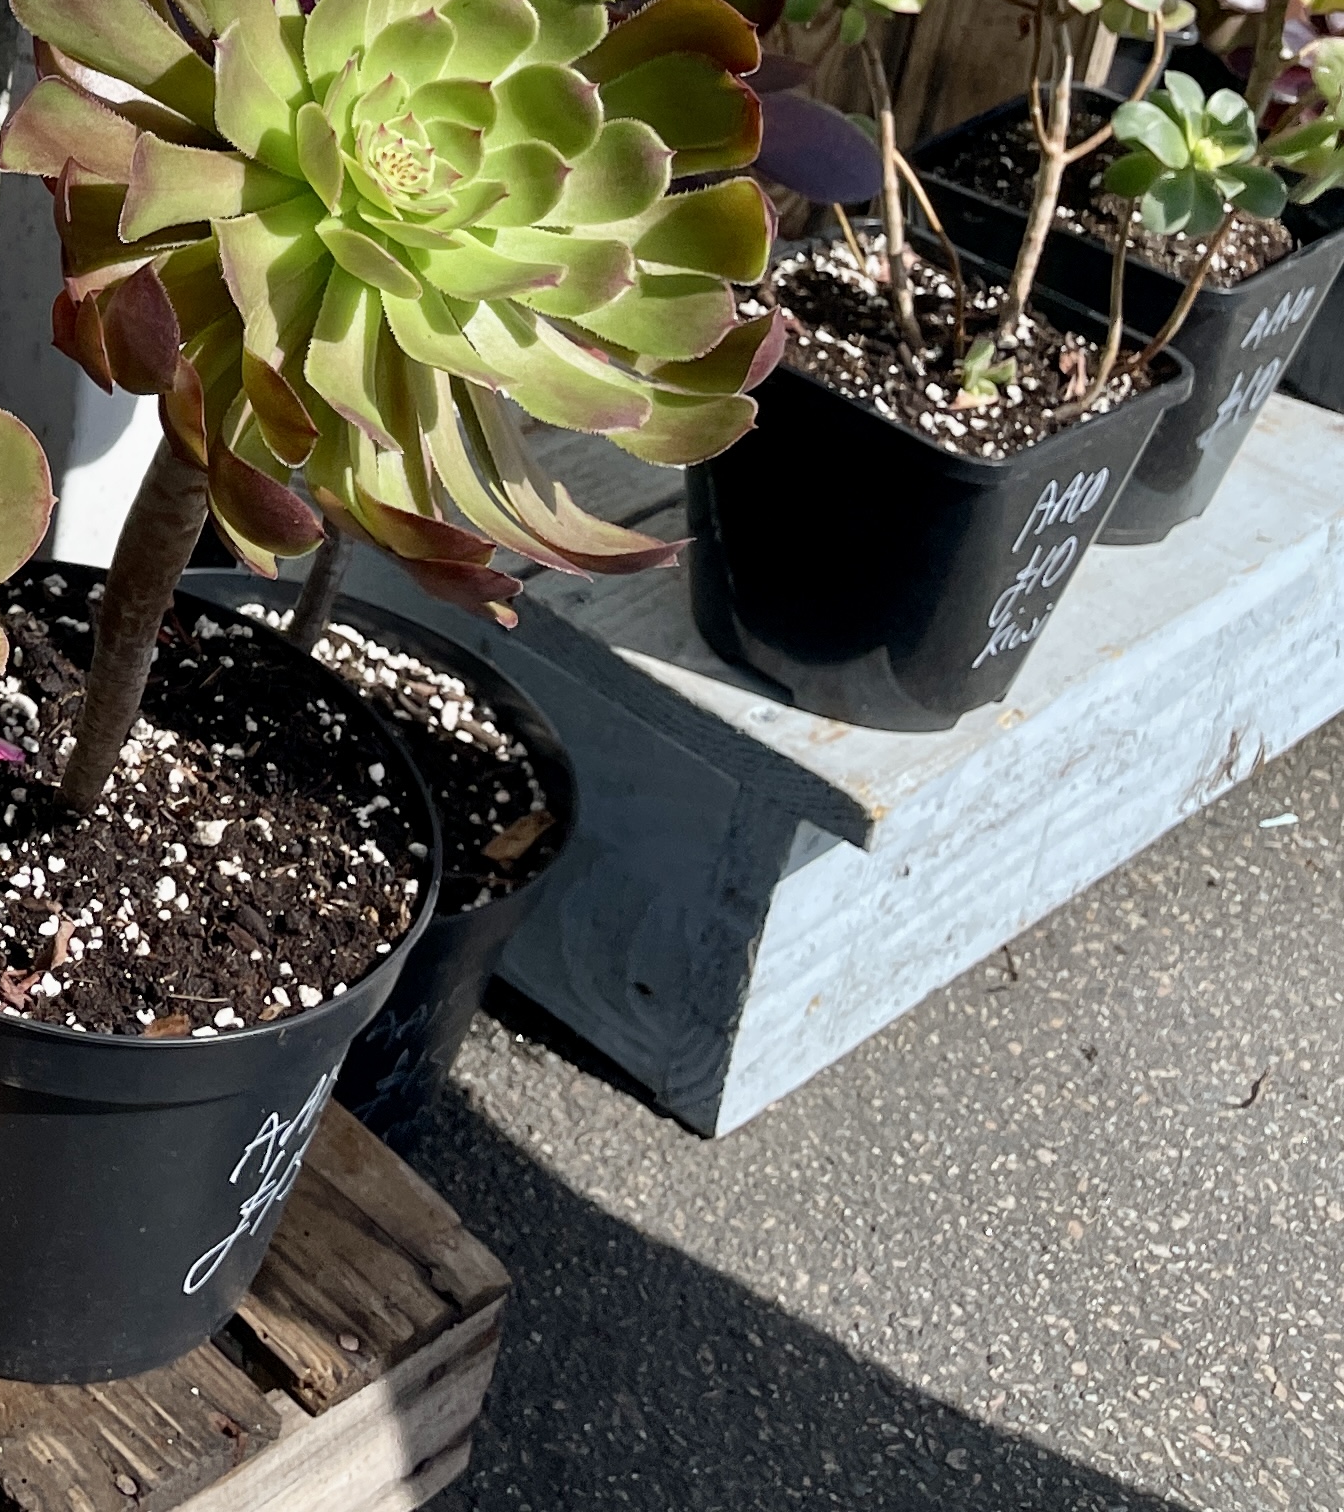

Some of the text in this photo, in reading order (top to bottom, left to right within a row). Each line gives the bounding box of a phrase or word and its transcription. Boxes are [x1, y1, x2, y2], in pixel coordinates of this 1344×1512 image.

[1240, 287, 1315, 351] AA10
[1195, 356, 1281, 449] £10
[1012, 467, 1110, 554] AA10
[988, 535, 1078, 628] £10
